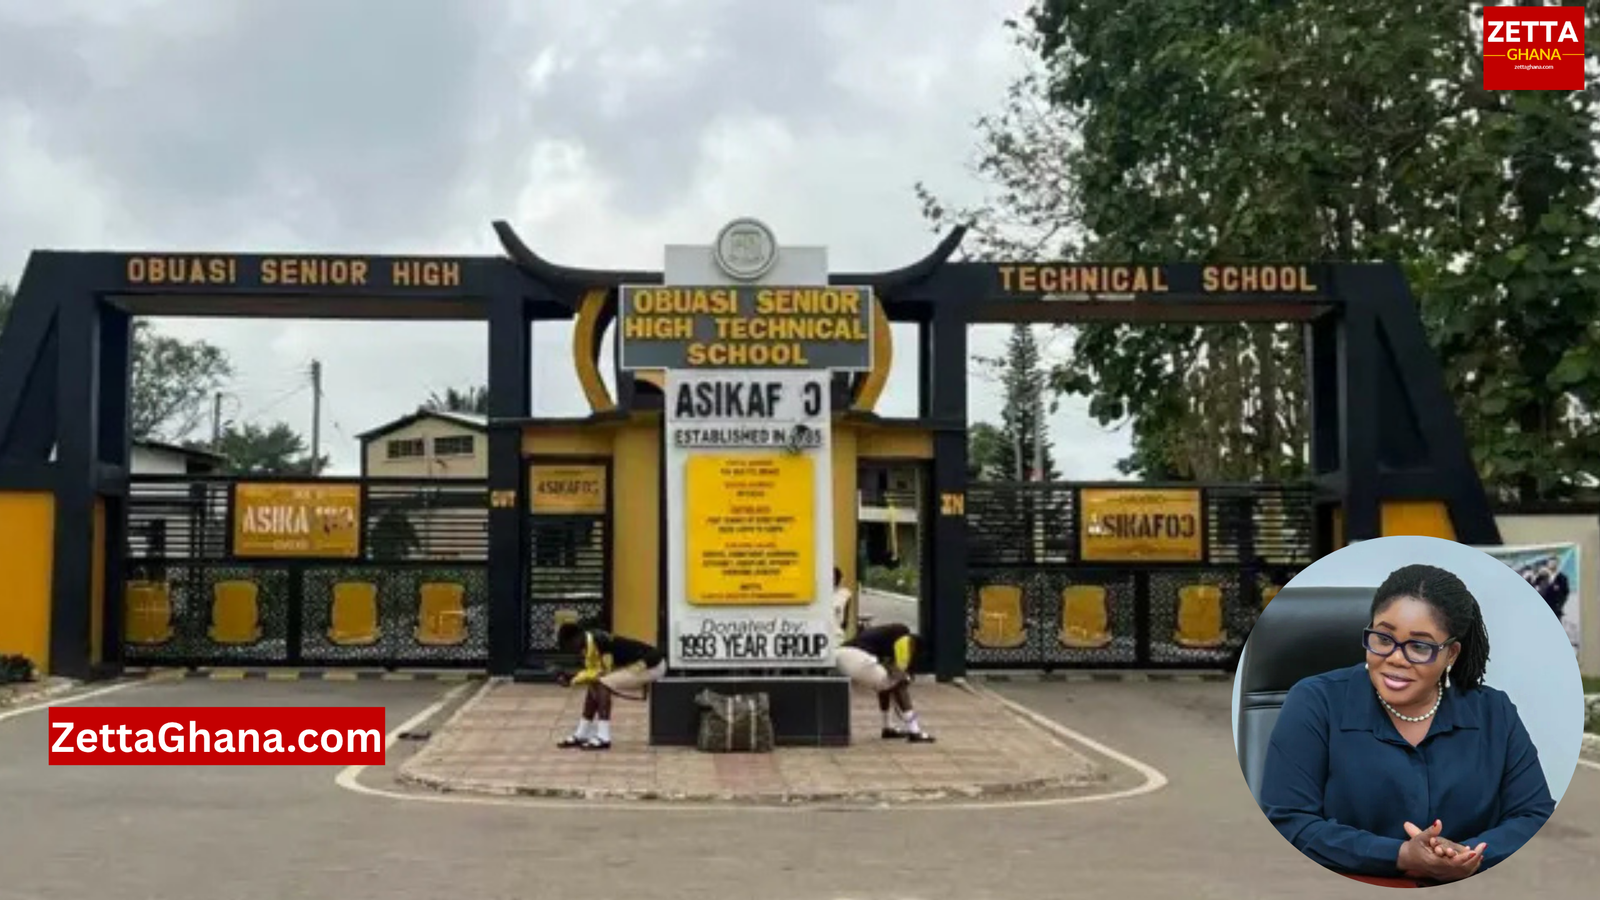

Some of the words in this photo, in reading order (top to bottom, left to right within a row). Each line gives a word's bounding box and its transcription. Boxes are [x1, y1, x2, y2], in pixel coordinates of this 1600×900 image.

[127, 257, 237, 284] OBUASI
[260, 259, 367, 285] SENIOR
[392, 261, 461, 286] HIGH
[999, 266, 1169, 293] TECHNICAL
[1202, 266, 1317, 293] SCHOOL
[633, 289, 738, 314] OBUASI
[756, 290, 860, 315] SENIOR
[625, 317, 693, 339] HIGH
[715, 317, 868, 340] TECHNICAL
[687, 343, 809, 366] SCHOOL
[675, 429, 770, 444] ESTABLISHED
[773, 429, 786, 444] IN
[701, 618, 775, 634] Donated
[679, 635, 716, 658] 1993
[723, 635, 767, 658] YEAR
[773, 634, 829, 658] GROUP
